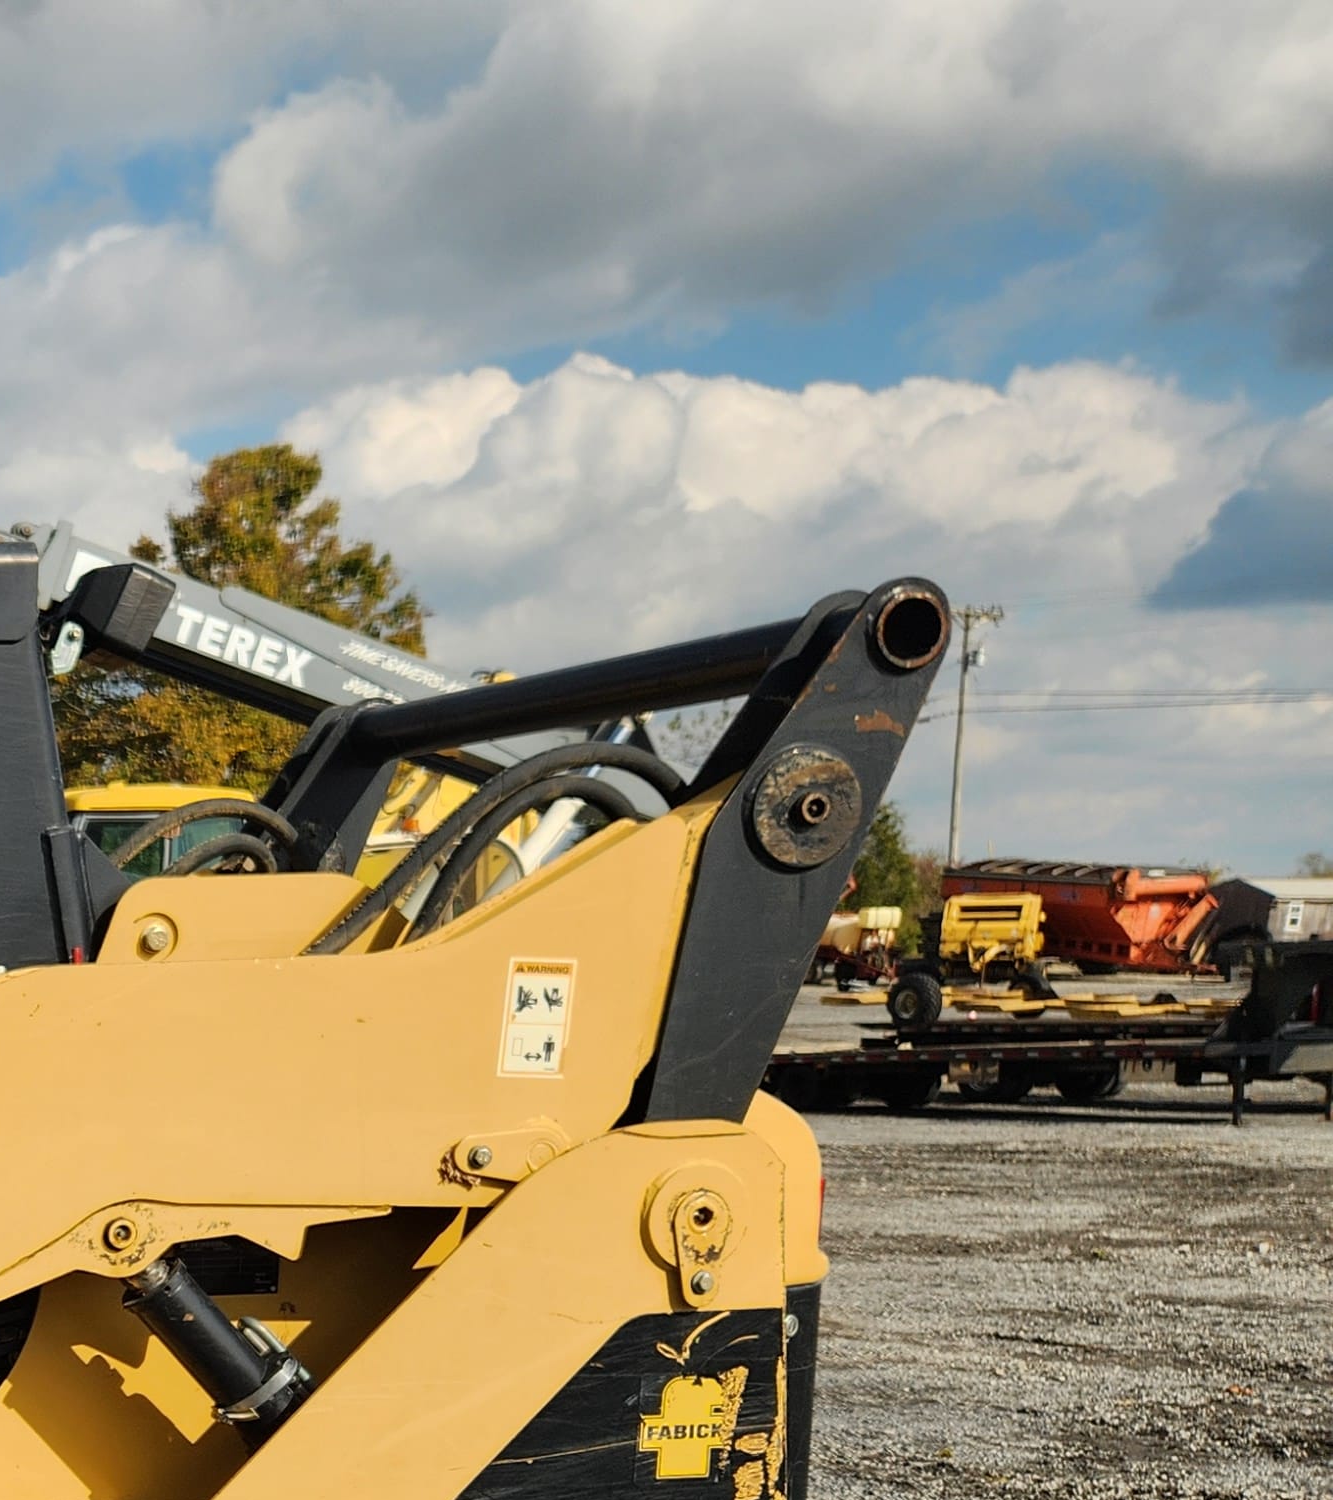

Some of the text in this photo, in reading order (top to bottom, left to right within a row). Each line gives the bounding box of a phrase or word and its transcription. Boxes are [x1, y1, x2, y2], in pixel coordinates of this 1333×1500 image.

[176, 605, 314, 688] TEREX
[526, 965, 570, 975] WARNING
[646, 1423, 723, 1441] FABICK
